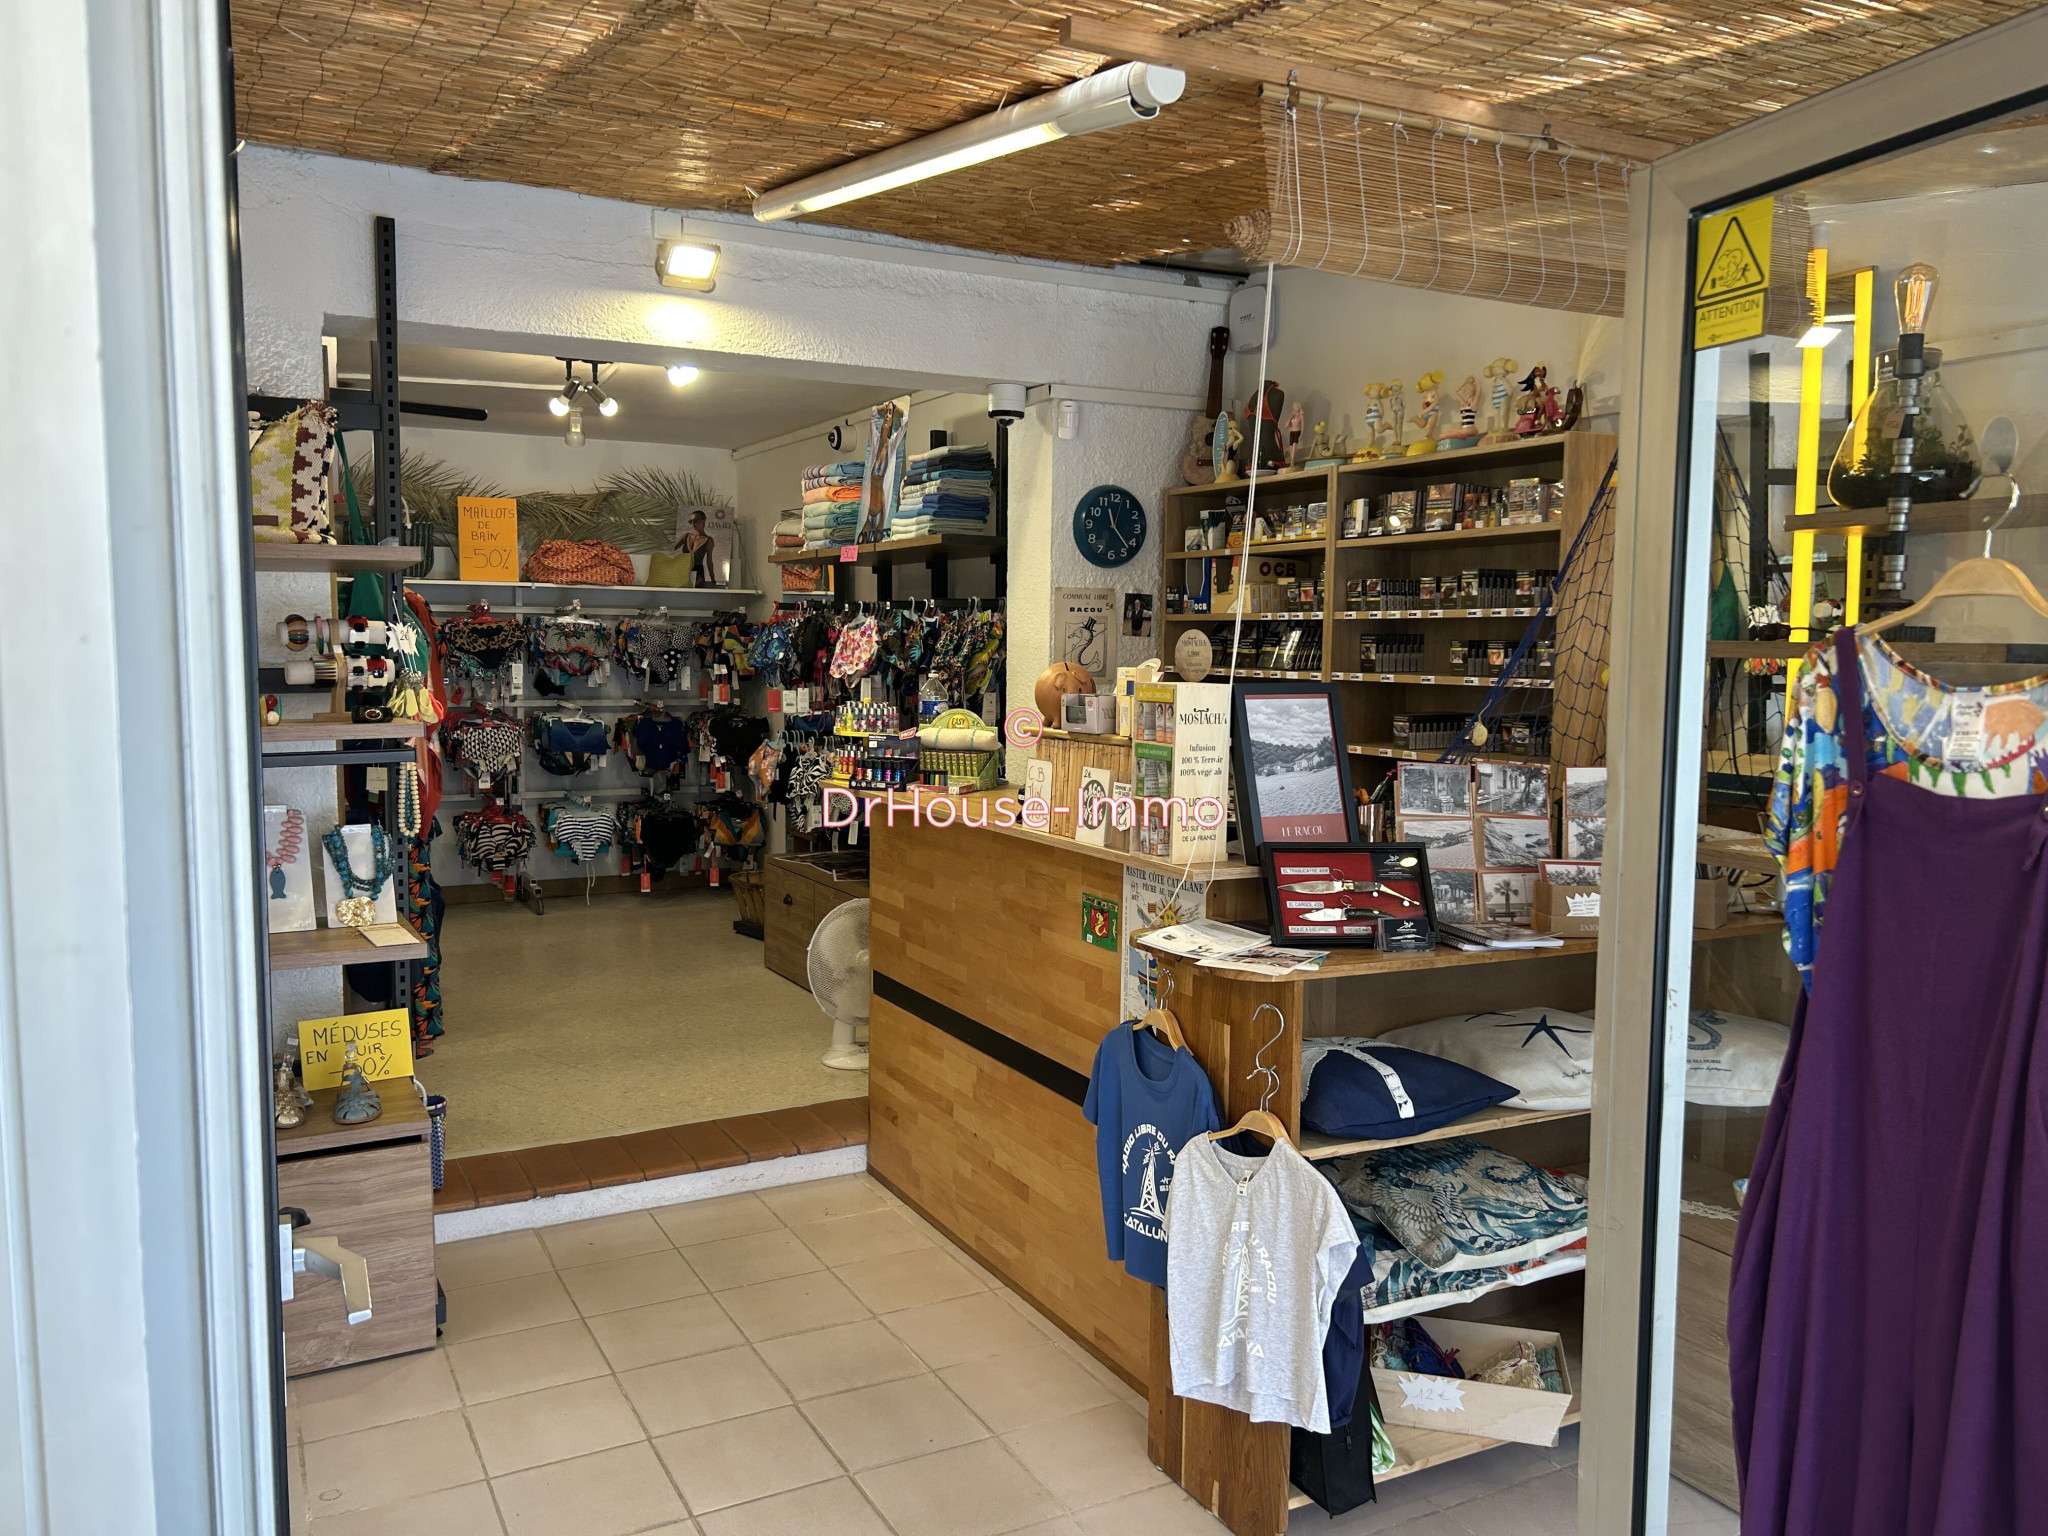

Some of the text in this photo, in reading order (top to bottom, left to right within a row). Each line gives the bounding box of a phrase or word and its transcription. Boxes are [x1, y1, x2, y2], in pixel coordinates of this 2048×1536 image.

[1699, 300, 1760, 321] ATTENTION
[1099, 497, 1108, 506] 11
[1110, 493, 1121, 503] 12
[1126, 500, 1130, 509] 1
[463, 506, 515, 519] MAILLOTS
[1090, 507, 1101, 517] 10
[1131, 511, 1139, 520] 2
[478, 520, 492, 530] DE
[1085, 519, 1093, 529] 9
[1133, 524, 1141, 534] 3
[471, 530, 500, 542] BAIN
[1087, 533, 1096, 544] 8
[1129, 537, 1137, 548] 4
[1097, 545, 1104, 553] 7
[1120, 548, 1127, 557] 5
[463, 547, 511, 570] -50%
[1107, 550, 1115, 560] 6
[1259, 561, 1297, 578] OCB
[1194, 602, 1207, 611] OCB
[1190, 744, 1216, 752] Infusion
[313, 1020, 402, 1046] MÉDUSES
[306, 1042, 386, 1065] EN UIR
[1134, 1123, 1157, 1139] LIBRE
[1156, 1131, 1169, 1149] DU
[1123, 1213, 1168, 1243] CATALUN
